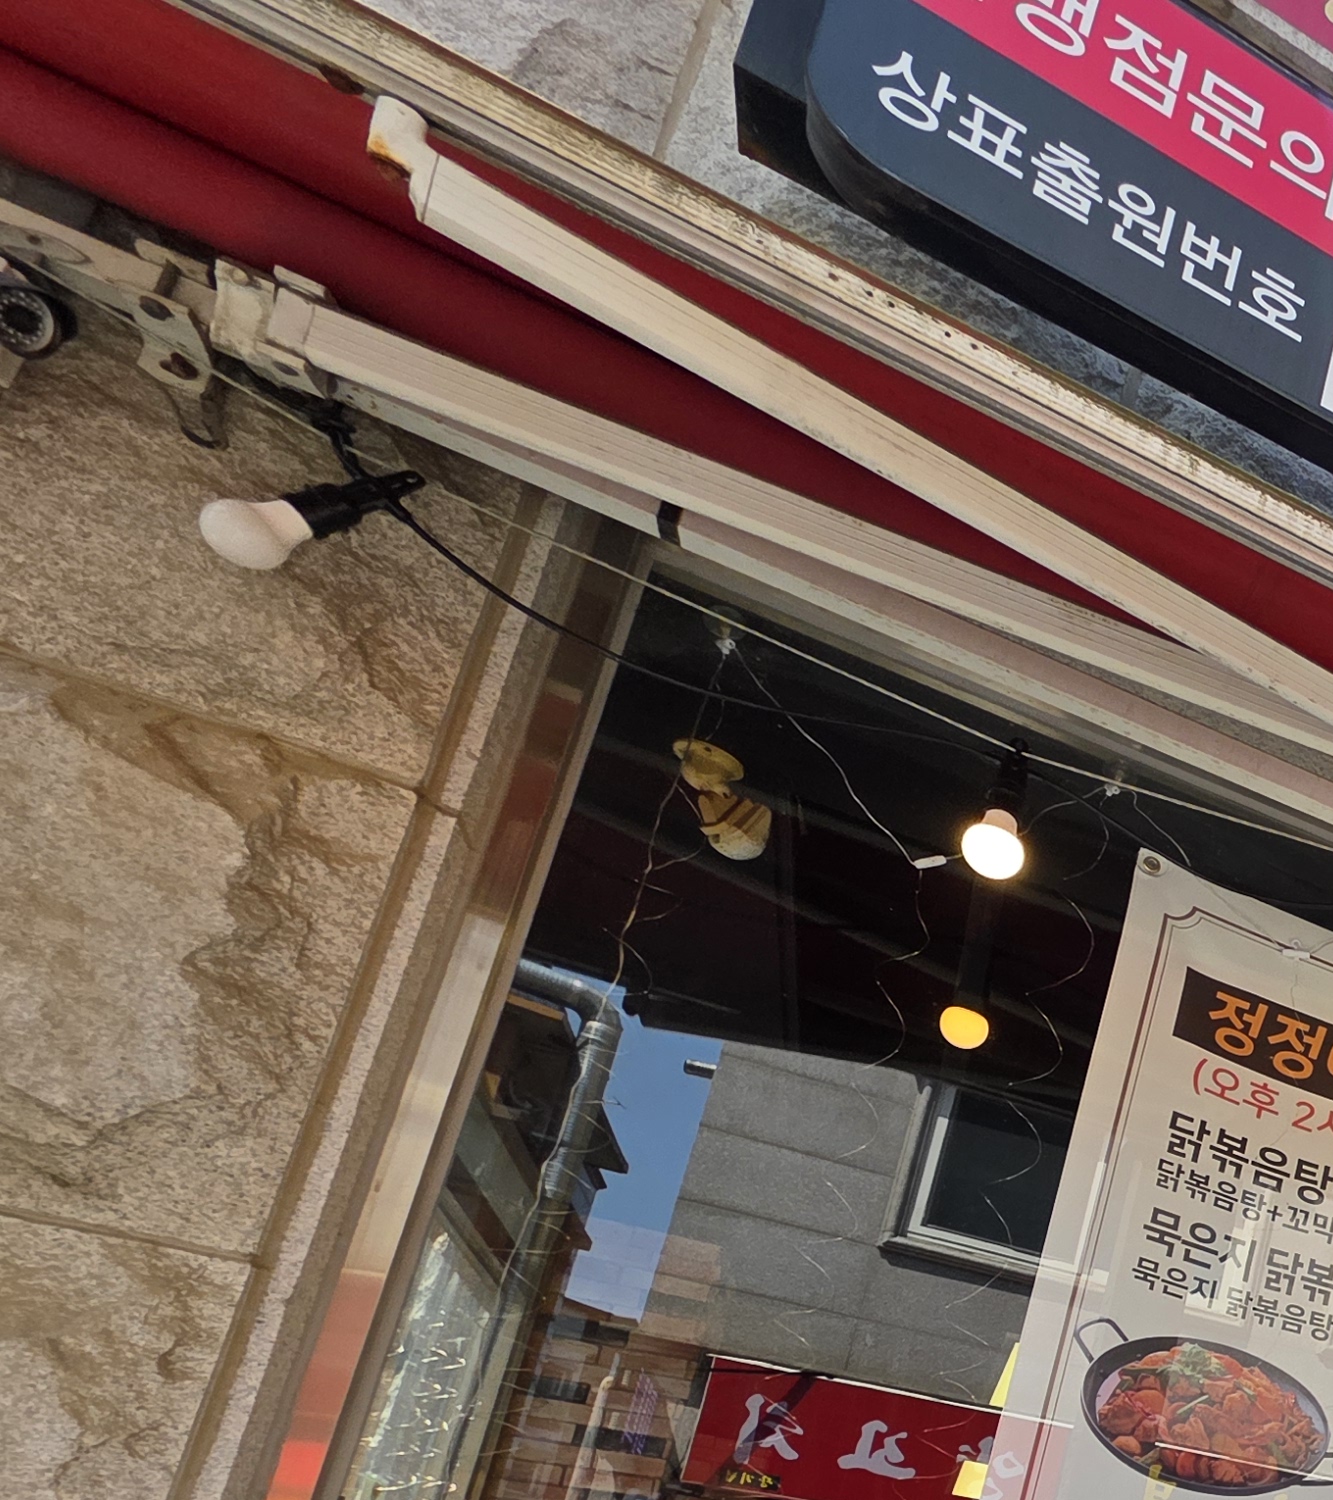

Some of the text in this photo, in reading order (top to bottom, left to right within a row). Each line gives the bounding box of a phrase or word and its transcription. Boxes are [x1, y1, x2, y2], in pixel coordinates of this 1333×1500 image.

[871, 51, 1306, 342] 상표출원번호
[1192, 1057, 1280, 1119] (오후
[1142, 1206, 1258, 1283] 묵은지
[1131, 1256, 1218, 1309] 묵은지
